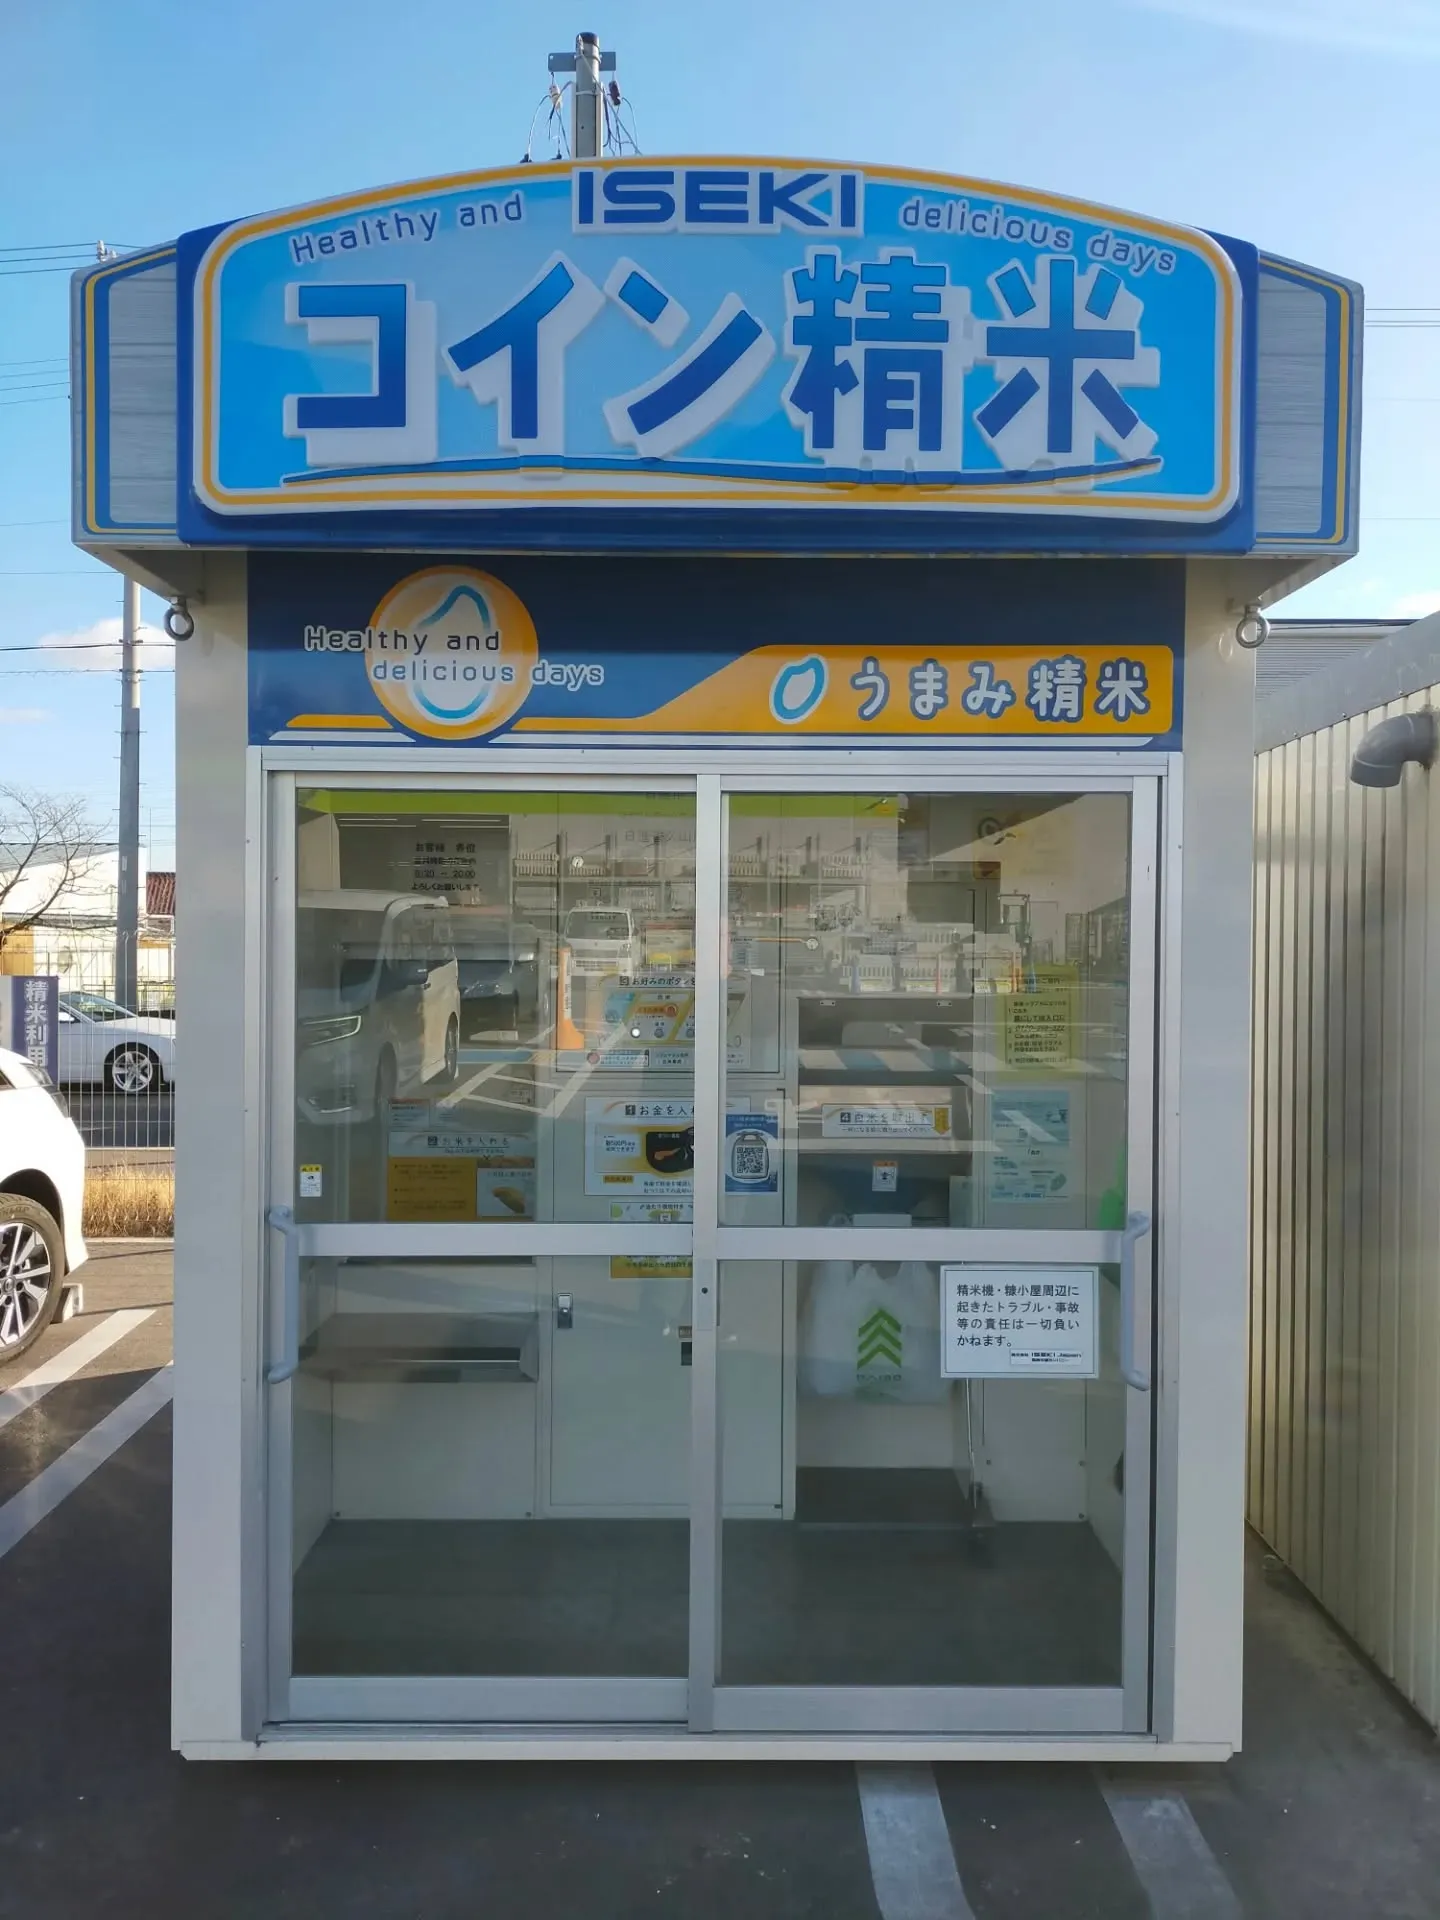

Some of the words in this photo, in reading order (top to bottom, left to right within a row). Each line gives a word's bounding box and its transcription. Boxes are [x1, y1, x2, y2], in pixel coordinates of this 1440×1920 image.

[577, 171, 856, 226] ISEKI
[292, 211, 438, 262] Healthy
[459, 193, 522, 227] and
[902, 199, 1071, 249] delicious
[1089, 234, 1174, 273] days
[296, 254, 1140, 453] コイン精米
[305, 628, 428, 655] Healthy
[446, 629, 500, 652] and
[372, 660, 514, 681] delicious
[532, 660, 604, 690] days
[850, 656, 1149, 722] うまみ精米
[957, 1284, 1080, 1297] 精米機・糠小屋周辺に
[957, 1301, 1080, 1314] 起きたトラブル・事故
[957, 1318, 1080, 1331] 等の責任は一切負い
[957, 1335, 1012, 1348] かねます。
